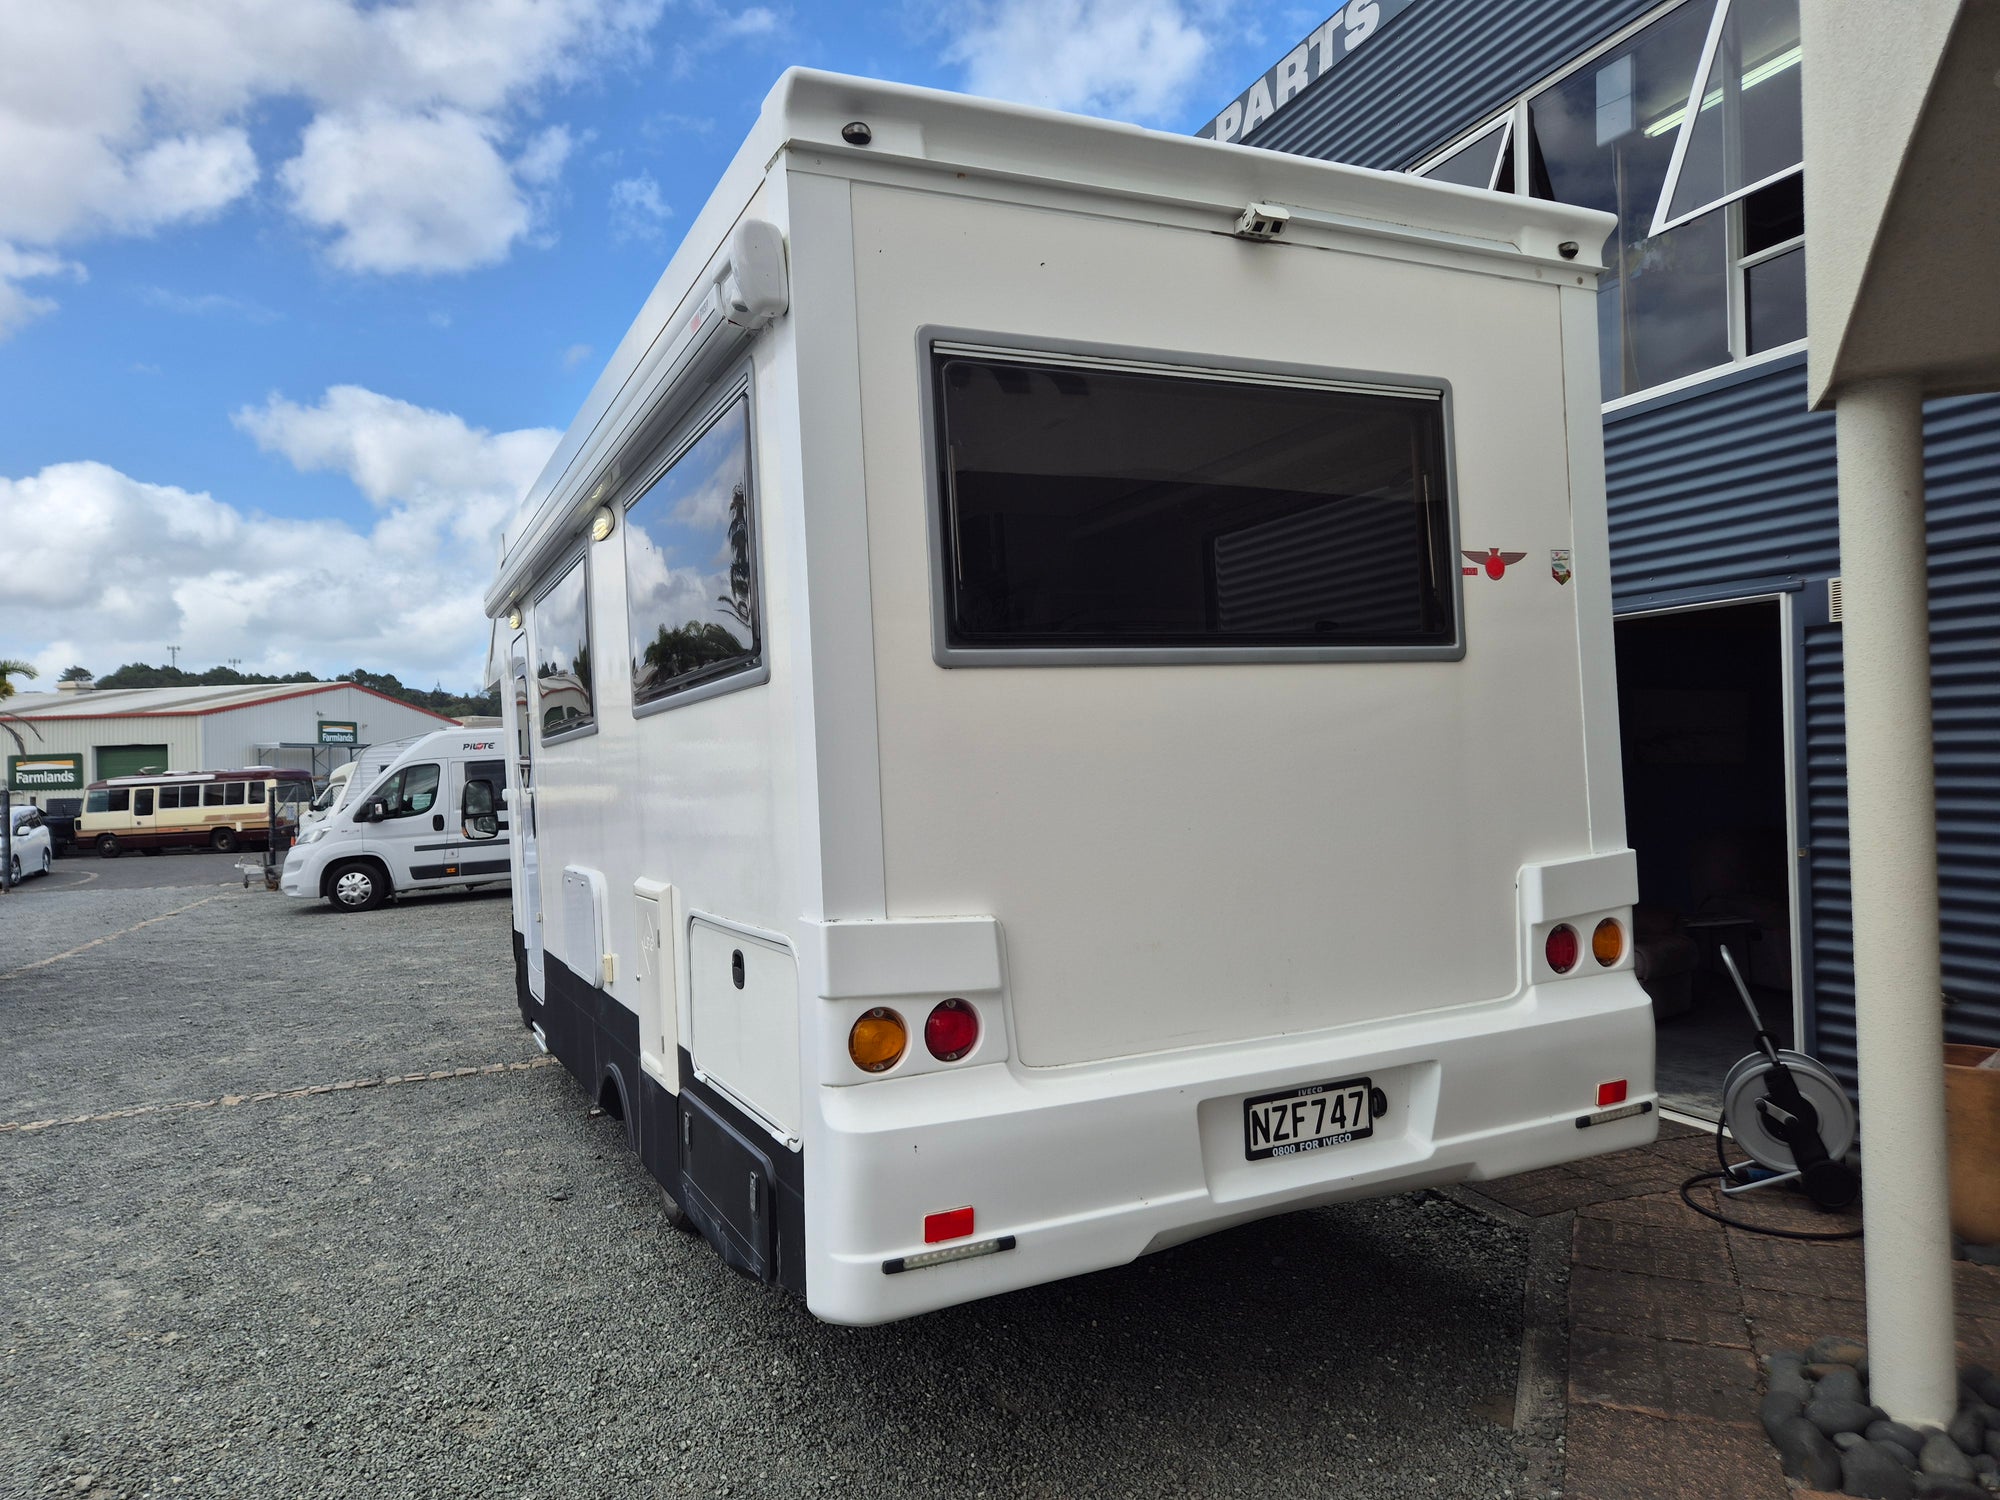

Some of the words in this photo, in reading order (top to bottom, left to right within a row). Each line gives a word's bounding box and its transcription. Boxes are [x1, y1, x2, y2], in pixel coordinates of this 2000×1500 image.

[1215, 0, 1380, 142] PARTS
[322, 732, 354, 742] Farmlands
[463, 742, 495, 751] PILOTE
[16, 770, 74, 784] Farmlands
[1298, 1086, 1323, 1096] IVECO
[1251, 1091, 1364, 1146] NZF747
[1272, 1144, 1296, 1157] 0800
[1299, 1140, 1319, 1151] FOR
[1323, 1133, 1352, 1147] IVECO
